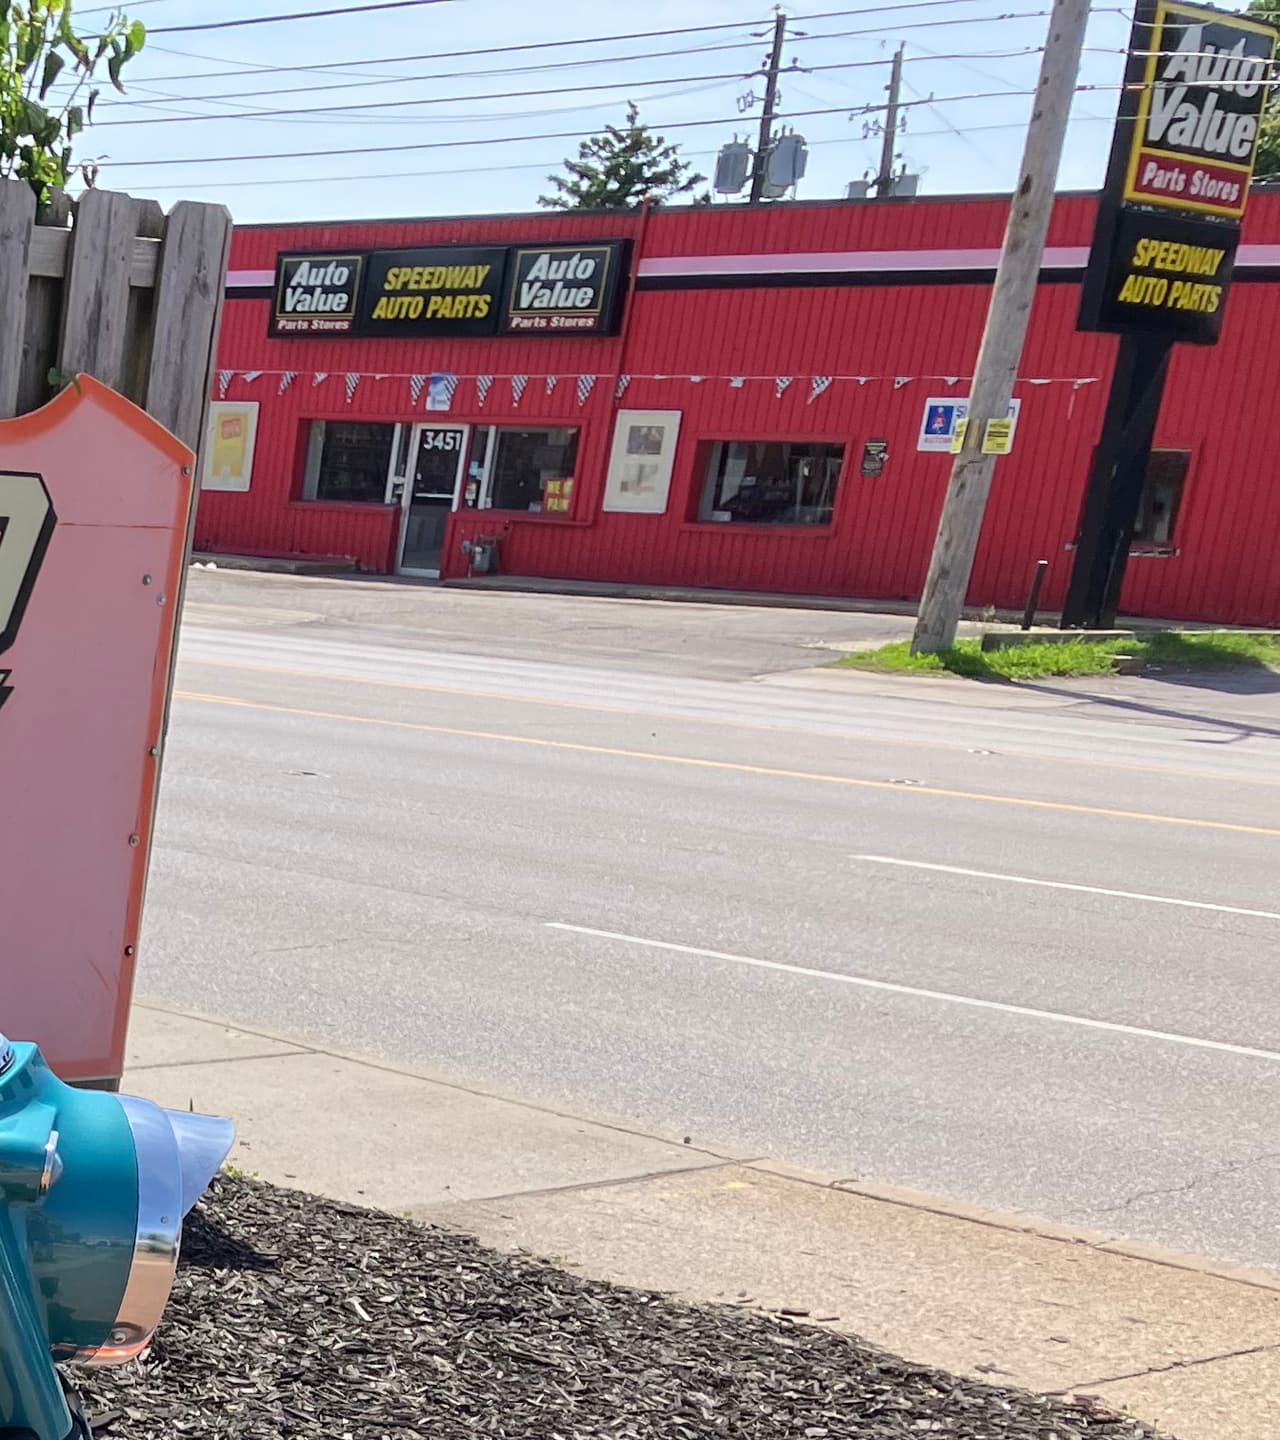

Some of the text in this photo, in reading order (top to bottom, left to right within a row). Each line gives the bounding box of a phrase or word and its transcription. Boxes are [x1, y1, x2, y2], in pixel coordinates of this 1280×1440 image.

[1163, 24, 1265, 98] Auto
[1147, 80, 1257, 158] Value
[1142, 161, 1240, 202] Parts Stores
[526, 252, 596, 281] Auto
[1132, 238, 1225, 276] SPEEDWAY
[290, 260, 350, 287] Auto
[384, 264, 491, 290] SPEEDWAY
[284, 287, 349, 313] Value
[371, 294, 492, 319] AUTO PARTS
[519, 281, 594, 309] Value
[1118, 274, 1222, 313] AUTO PARTS
[277, 319, 351, 331] Parts Stores
[510, 315, 595, 329] Parts Stores
[423, 431, 462, 450] 3451
